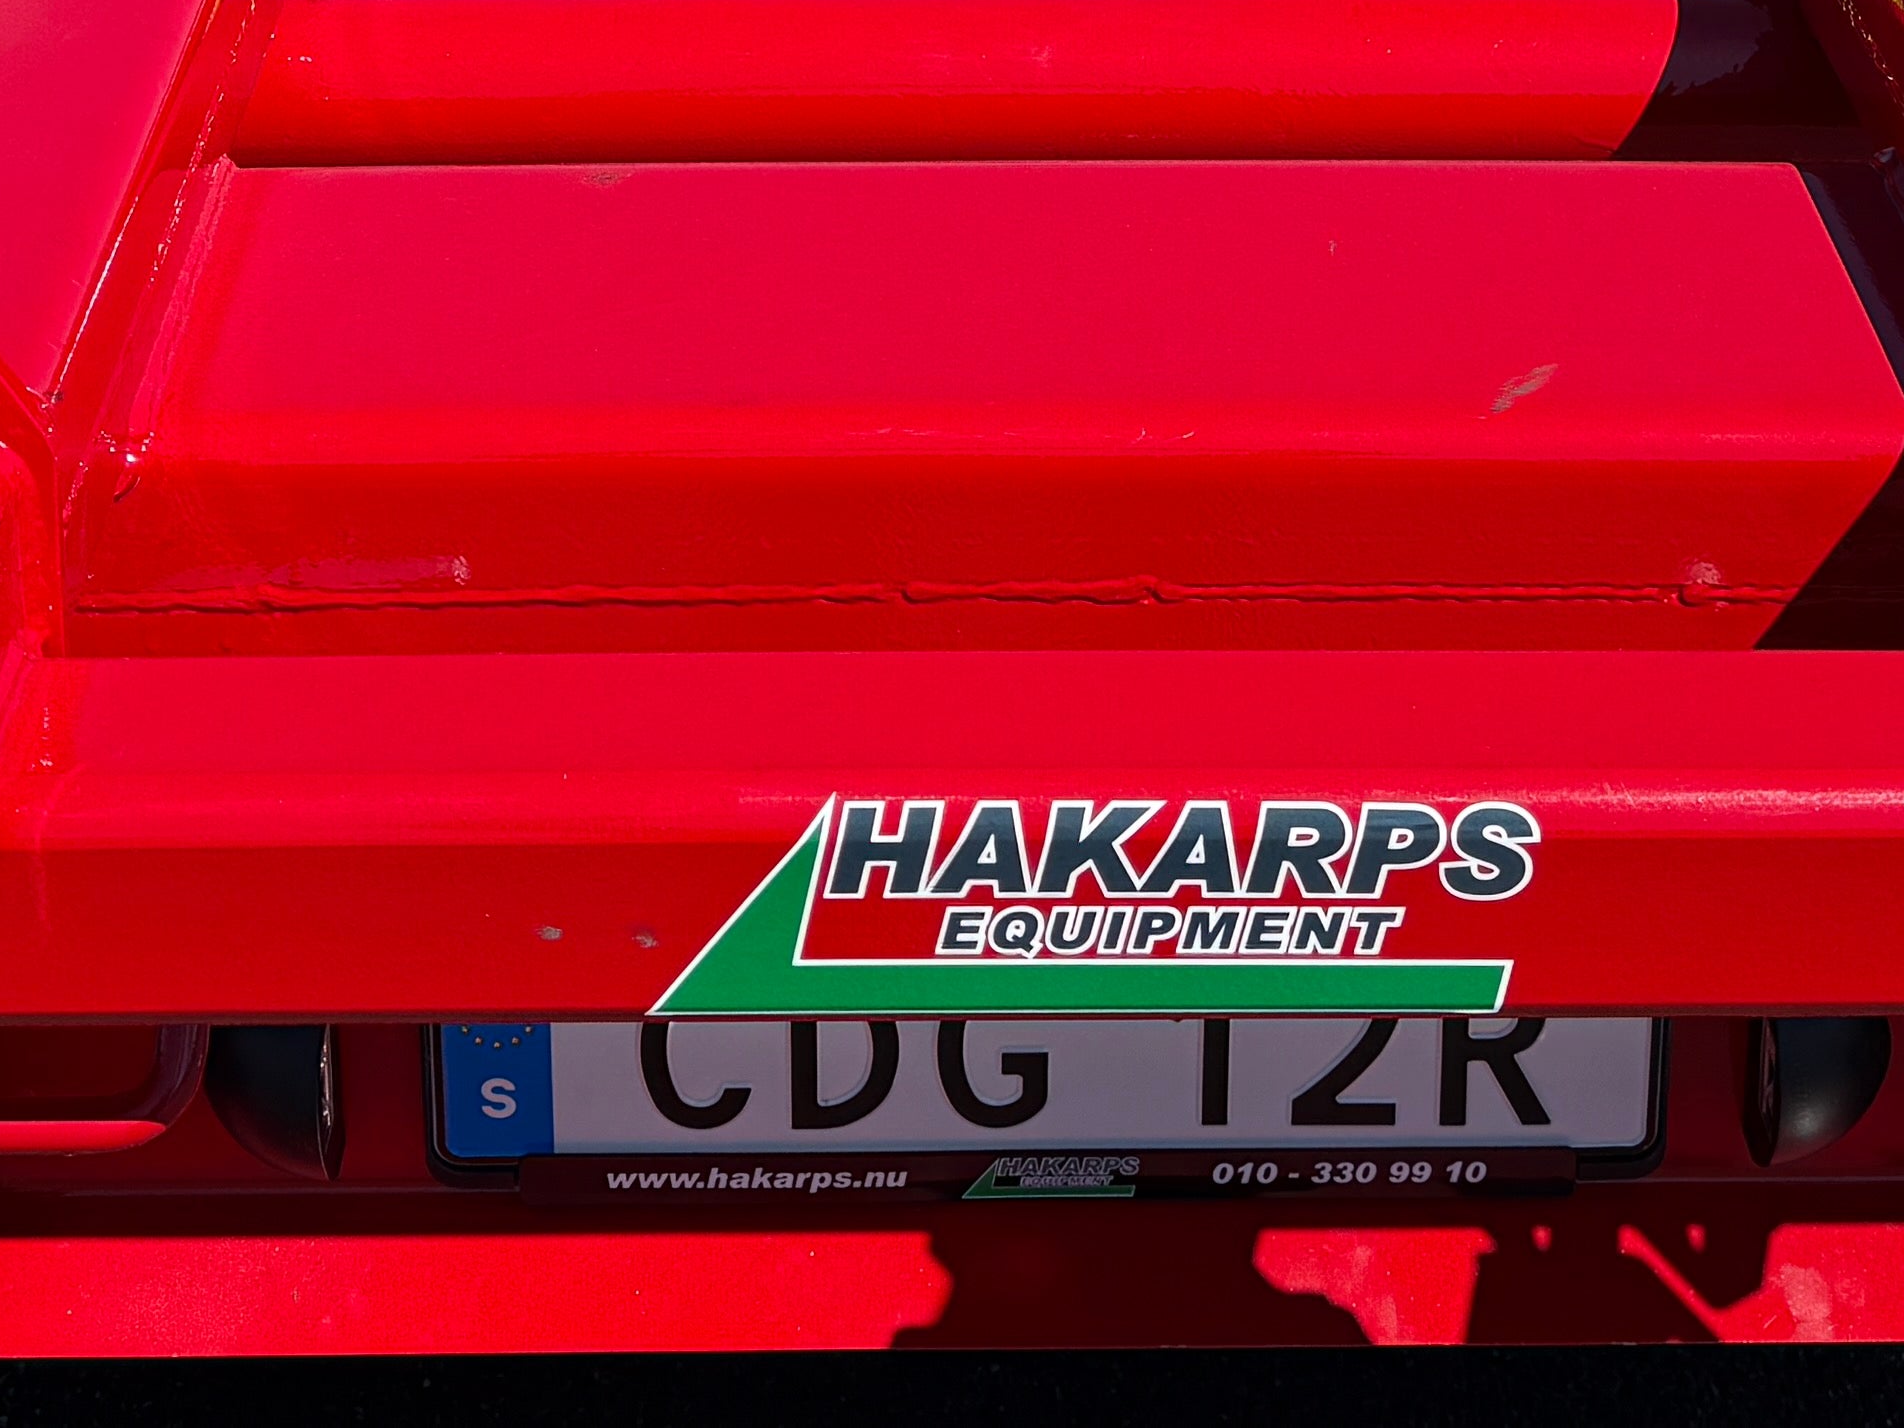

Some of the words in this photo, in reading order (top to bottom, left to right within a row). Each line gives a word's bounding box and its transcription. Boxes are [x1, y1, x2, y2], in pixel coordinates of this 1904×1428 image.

[823, 798, 1544, 901] HAKARPS
[933, 904, 1404, 959] EQUIPMENT
[480, 1077, 517, 1119] S
[997, 1156, 1140, 1175] HAKARPS
[1212, 1162, 1279, 1185] 010
[1310, 1161, 1378, 1184] 330
[1388, 1161, 1434, 1184] 99
[1444, 1160, 1488, 1183] 10
[606, 1167, 908, 1195] www.hakarps.nu
[1019, 1175, 1114, 1187] EQUIPMENT
